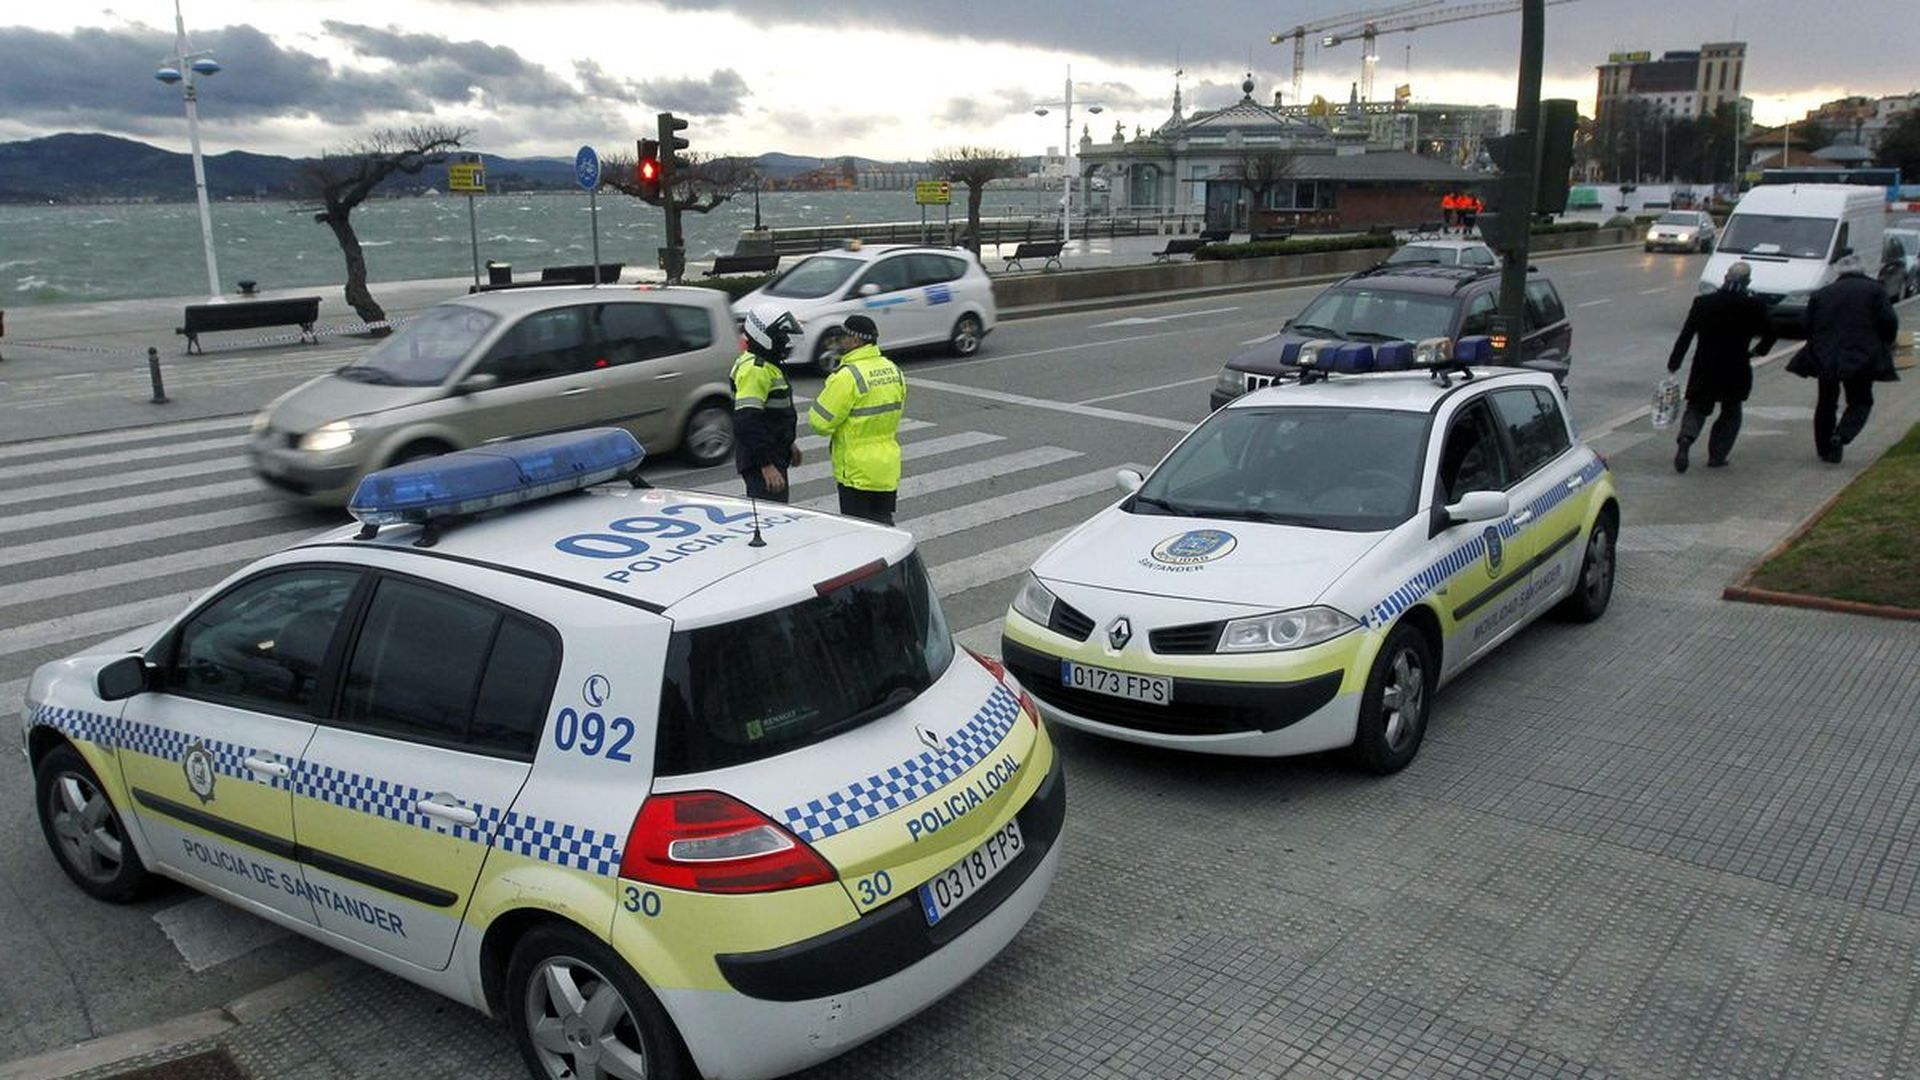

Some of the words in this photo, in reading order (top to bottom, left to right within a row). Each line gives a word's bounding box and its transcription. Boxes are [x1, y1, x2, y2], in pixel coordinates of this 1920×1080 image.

[554, 504, 759, 560] 092
[603, 534, 738, 584] POLICIA
[1074, 666, 1120, 693] 0173
[1126, 676, 1165, 701] FPS
[555, 707, 635, 763] 092
[906, 786, 984, 843] POLICIA
[977, 754, 1022, 799] LOCAL
[182, 838, 251, 880] POLICIA
[252, 864, 280, 889] DE
[281, 873, 408, 938] SANTANDER
[857, 870, 892, 906] 30
[935, 851, 987, 909] 0318
[987, 820, 1021, 869] FPS
[623, 886, 662, 918] 30
